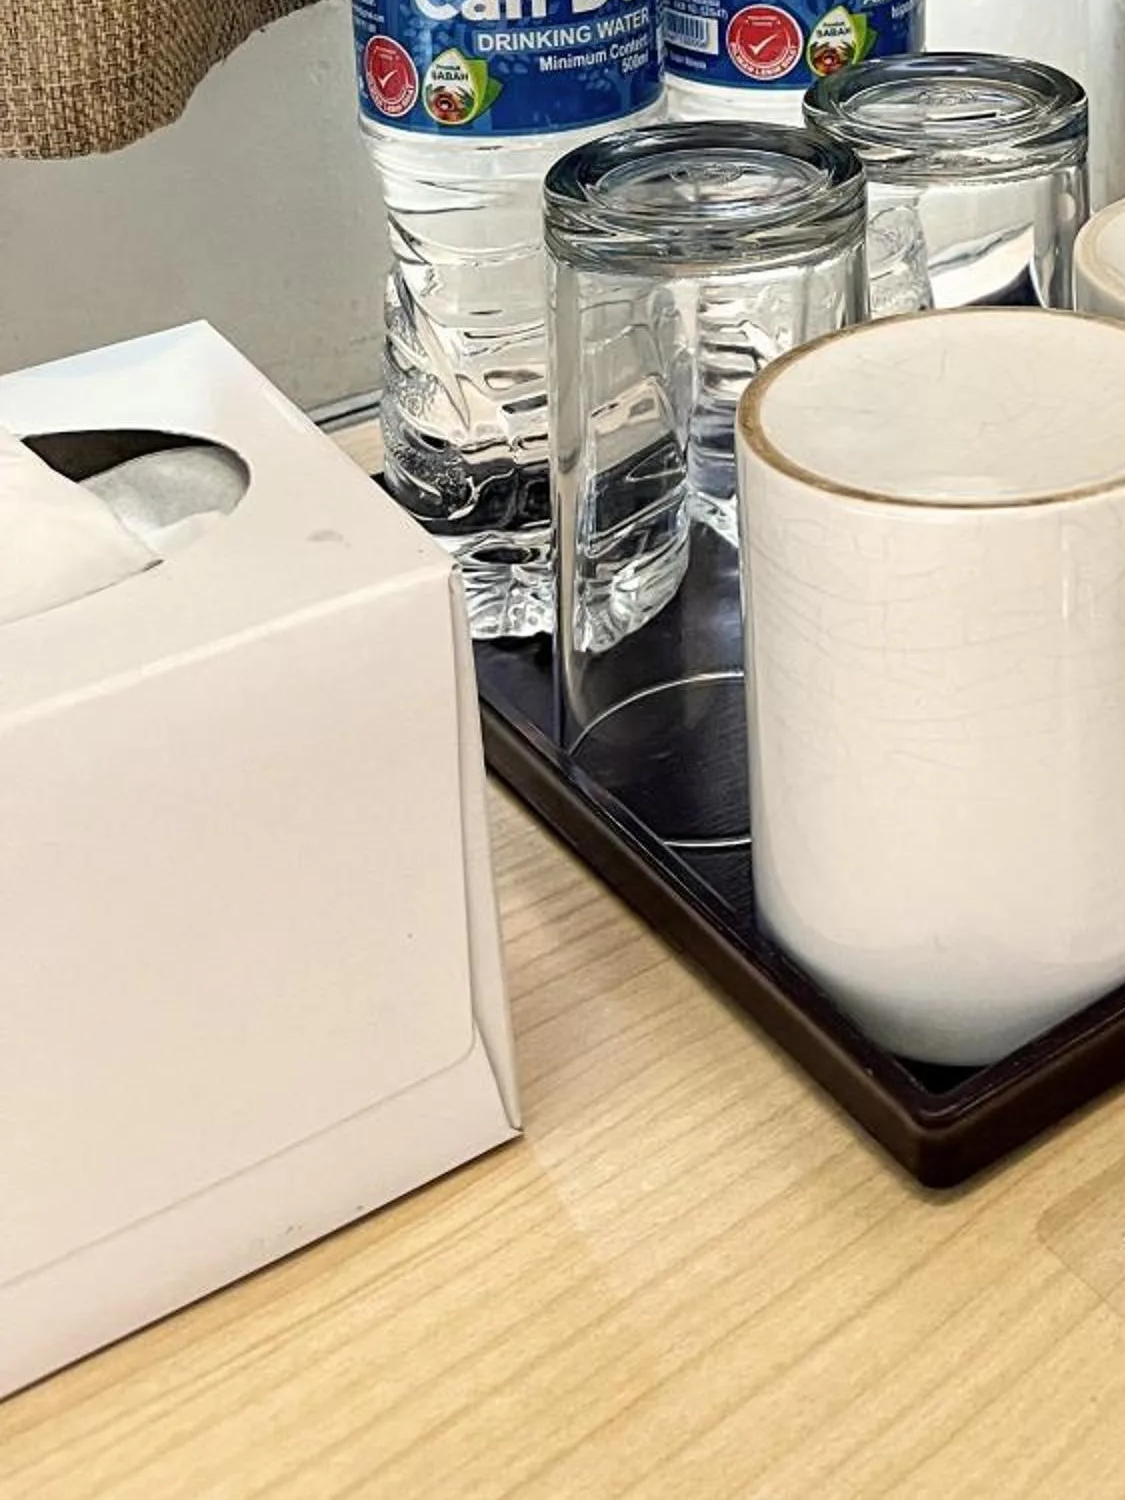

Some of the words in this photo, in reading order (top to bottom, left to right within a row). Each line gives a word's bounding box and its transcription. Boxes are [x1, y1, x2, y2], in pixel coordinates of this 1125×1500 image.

[477, 25, 591, 51] DRINKING
[597, 6, 649, 39] WATER
[539, 49, 607, 72] Minimum
